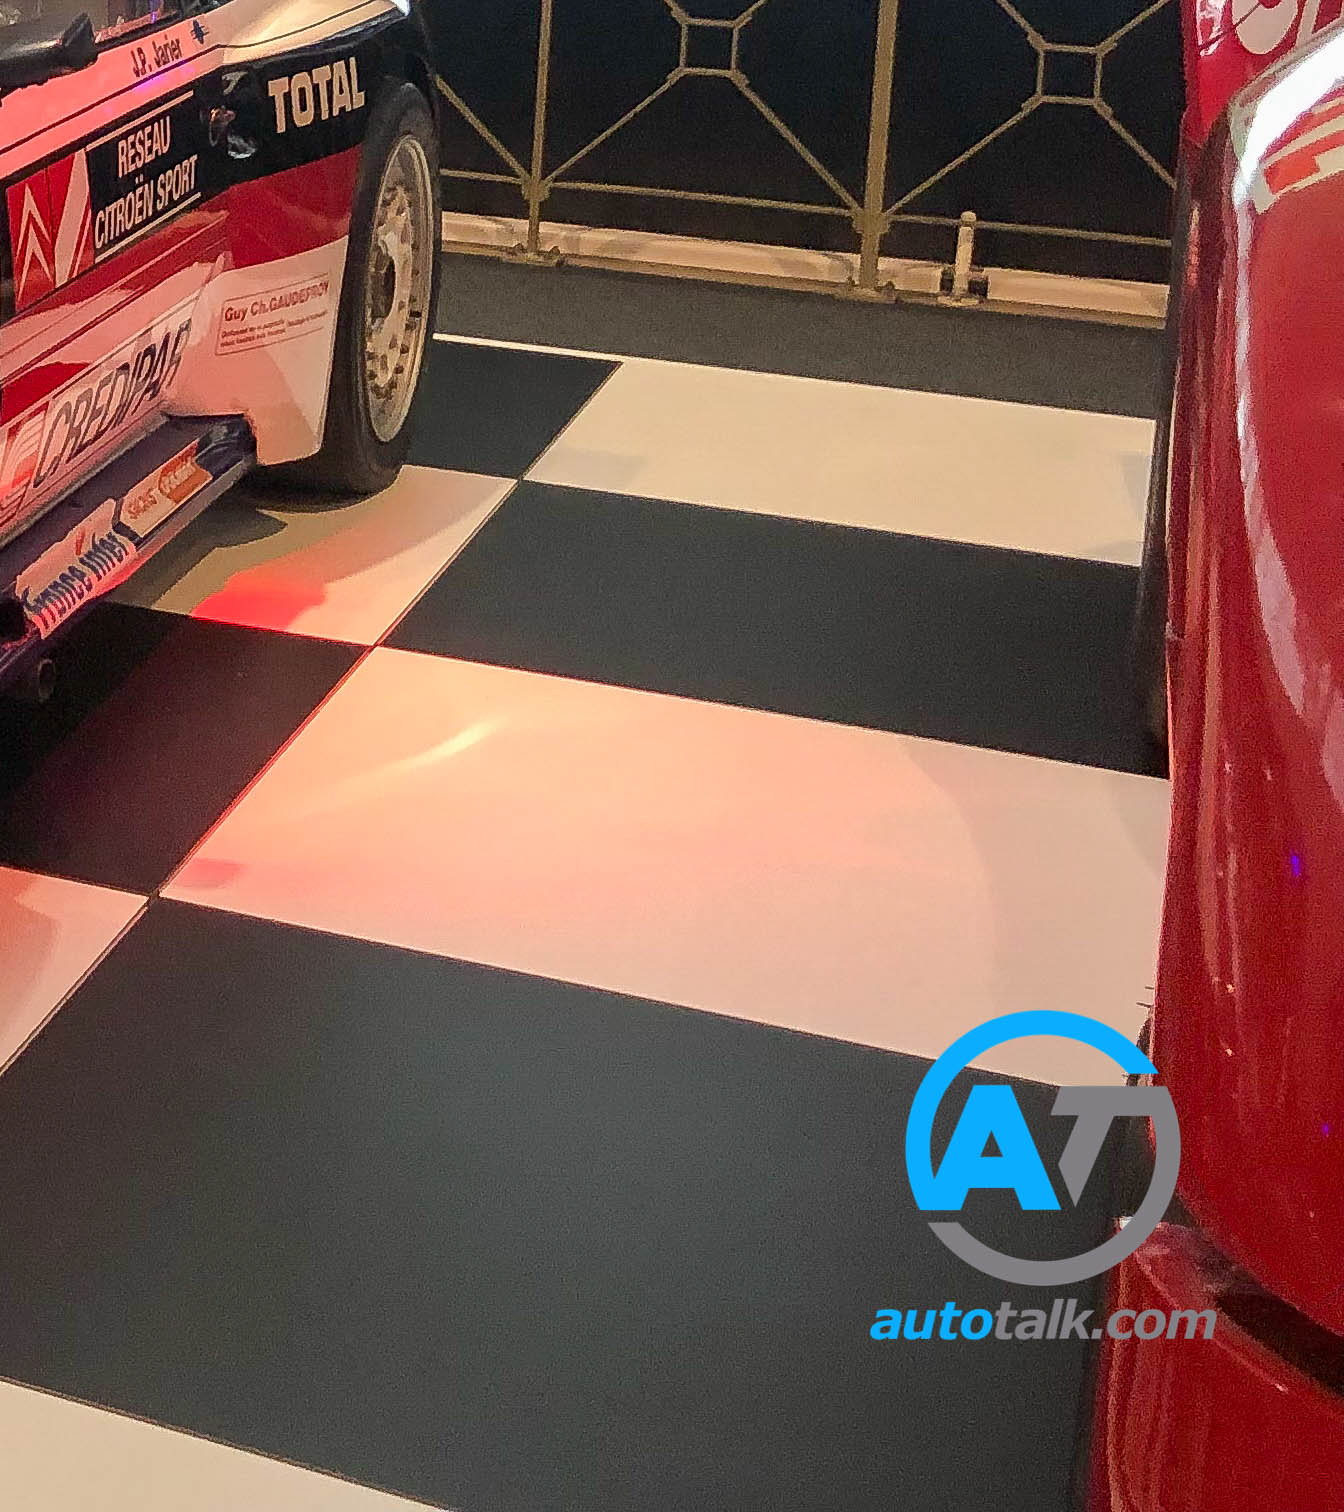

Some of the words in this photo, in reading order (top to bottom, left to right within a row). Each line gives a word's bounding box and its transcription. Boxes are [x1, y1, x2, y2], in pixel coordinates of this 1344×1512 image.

[267, 56, 365, 134] TOTAL
[117, 115, 172, 179] RESEAU
[94, 172, 155, 249] CITROËN
[155, 153, 199, 211] SPORT
